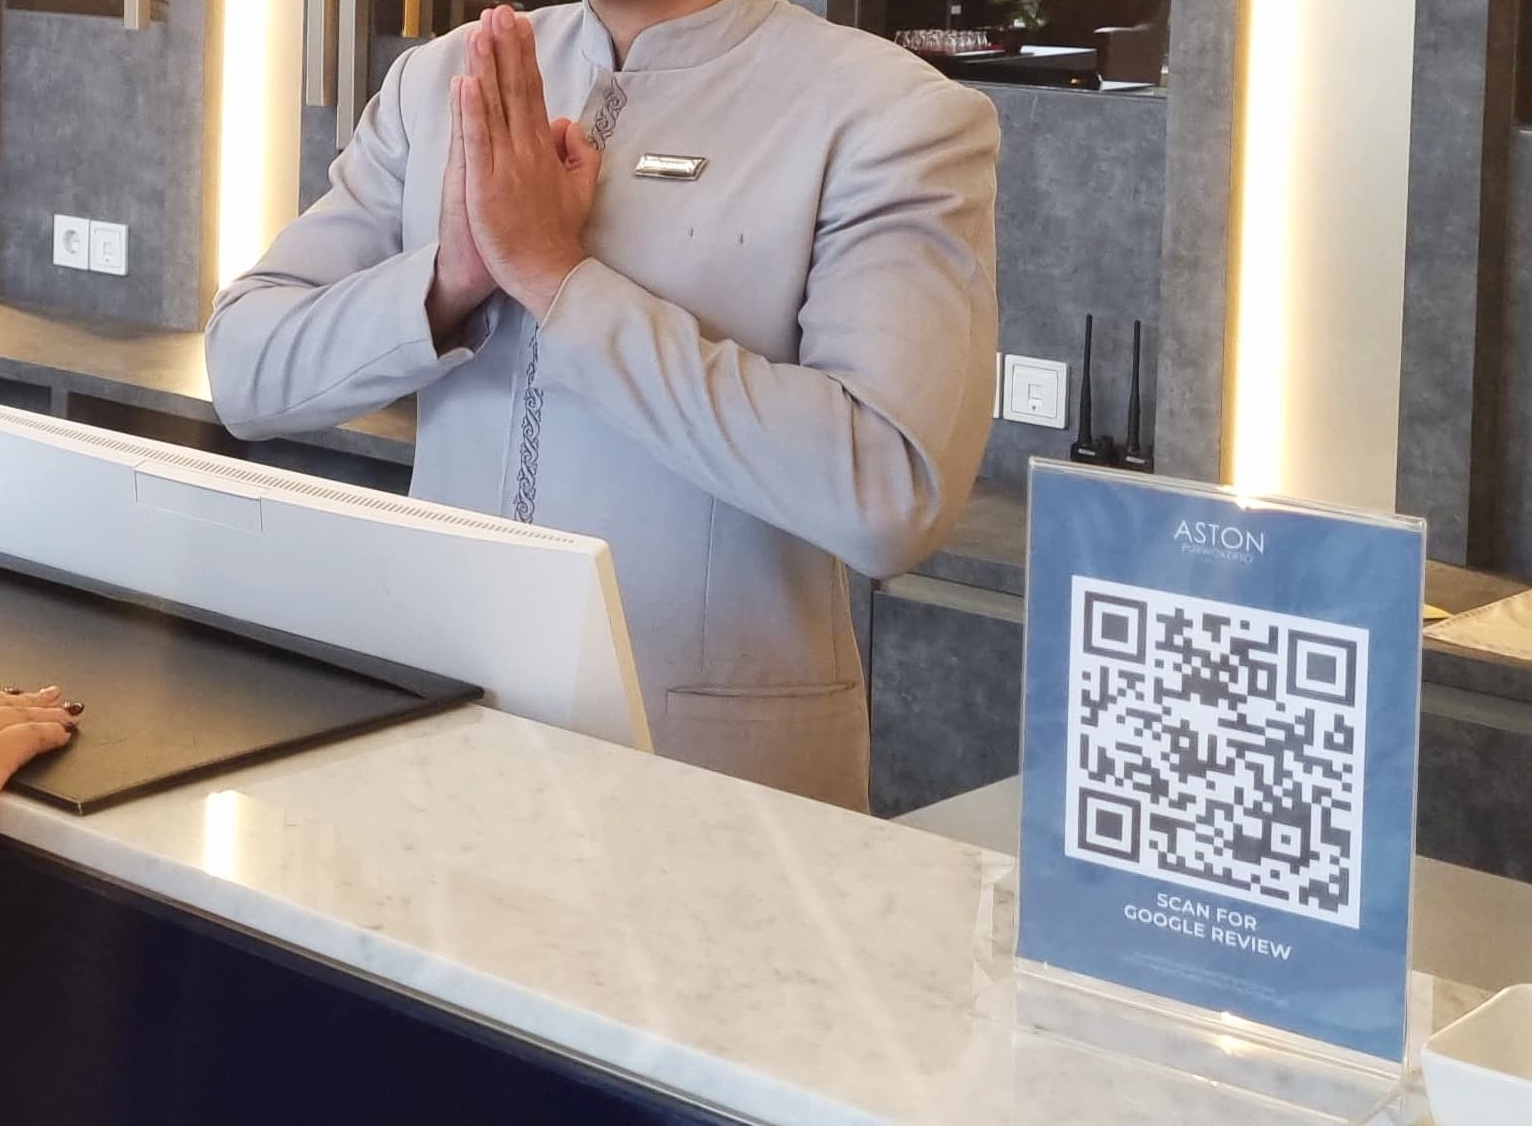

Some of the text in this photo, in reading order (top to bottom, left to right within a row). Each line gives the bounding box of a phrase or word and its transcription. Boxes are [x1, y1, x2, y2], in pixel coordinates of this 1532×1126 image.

[1173, 519, 1265, 555] ASTON
[1124, 904, 1292, 960] GOOGLE REVIEW
[1156, 892, 1258, 932] SCAN FOR
